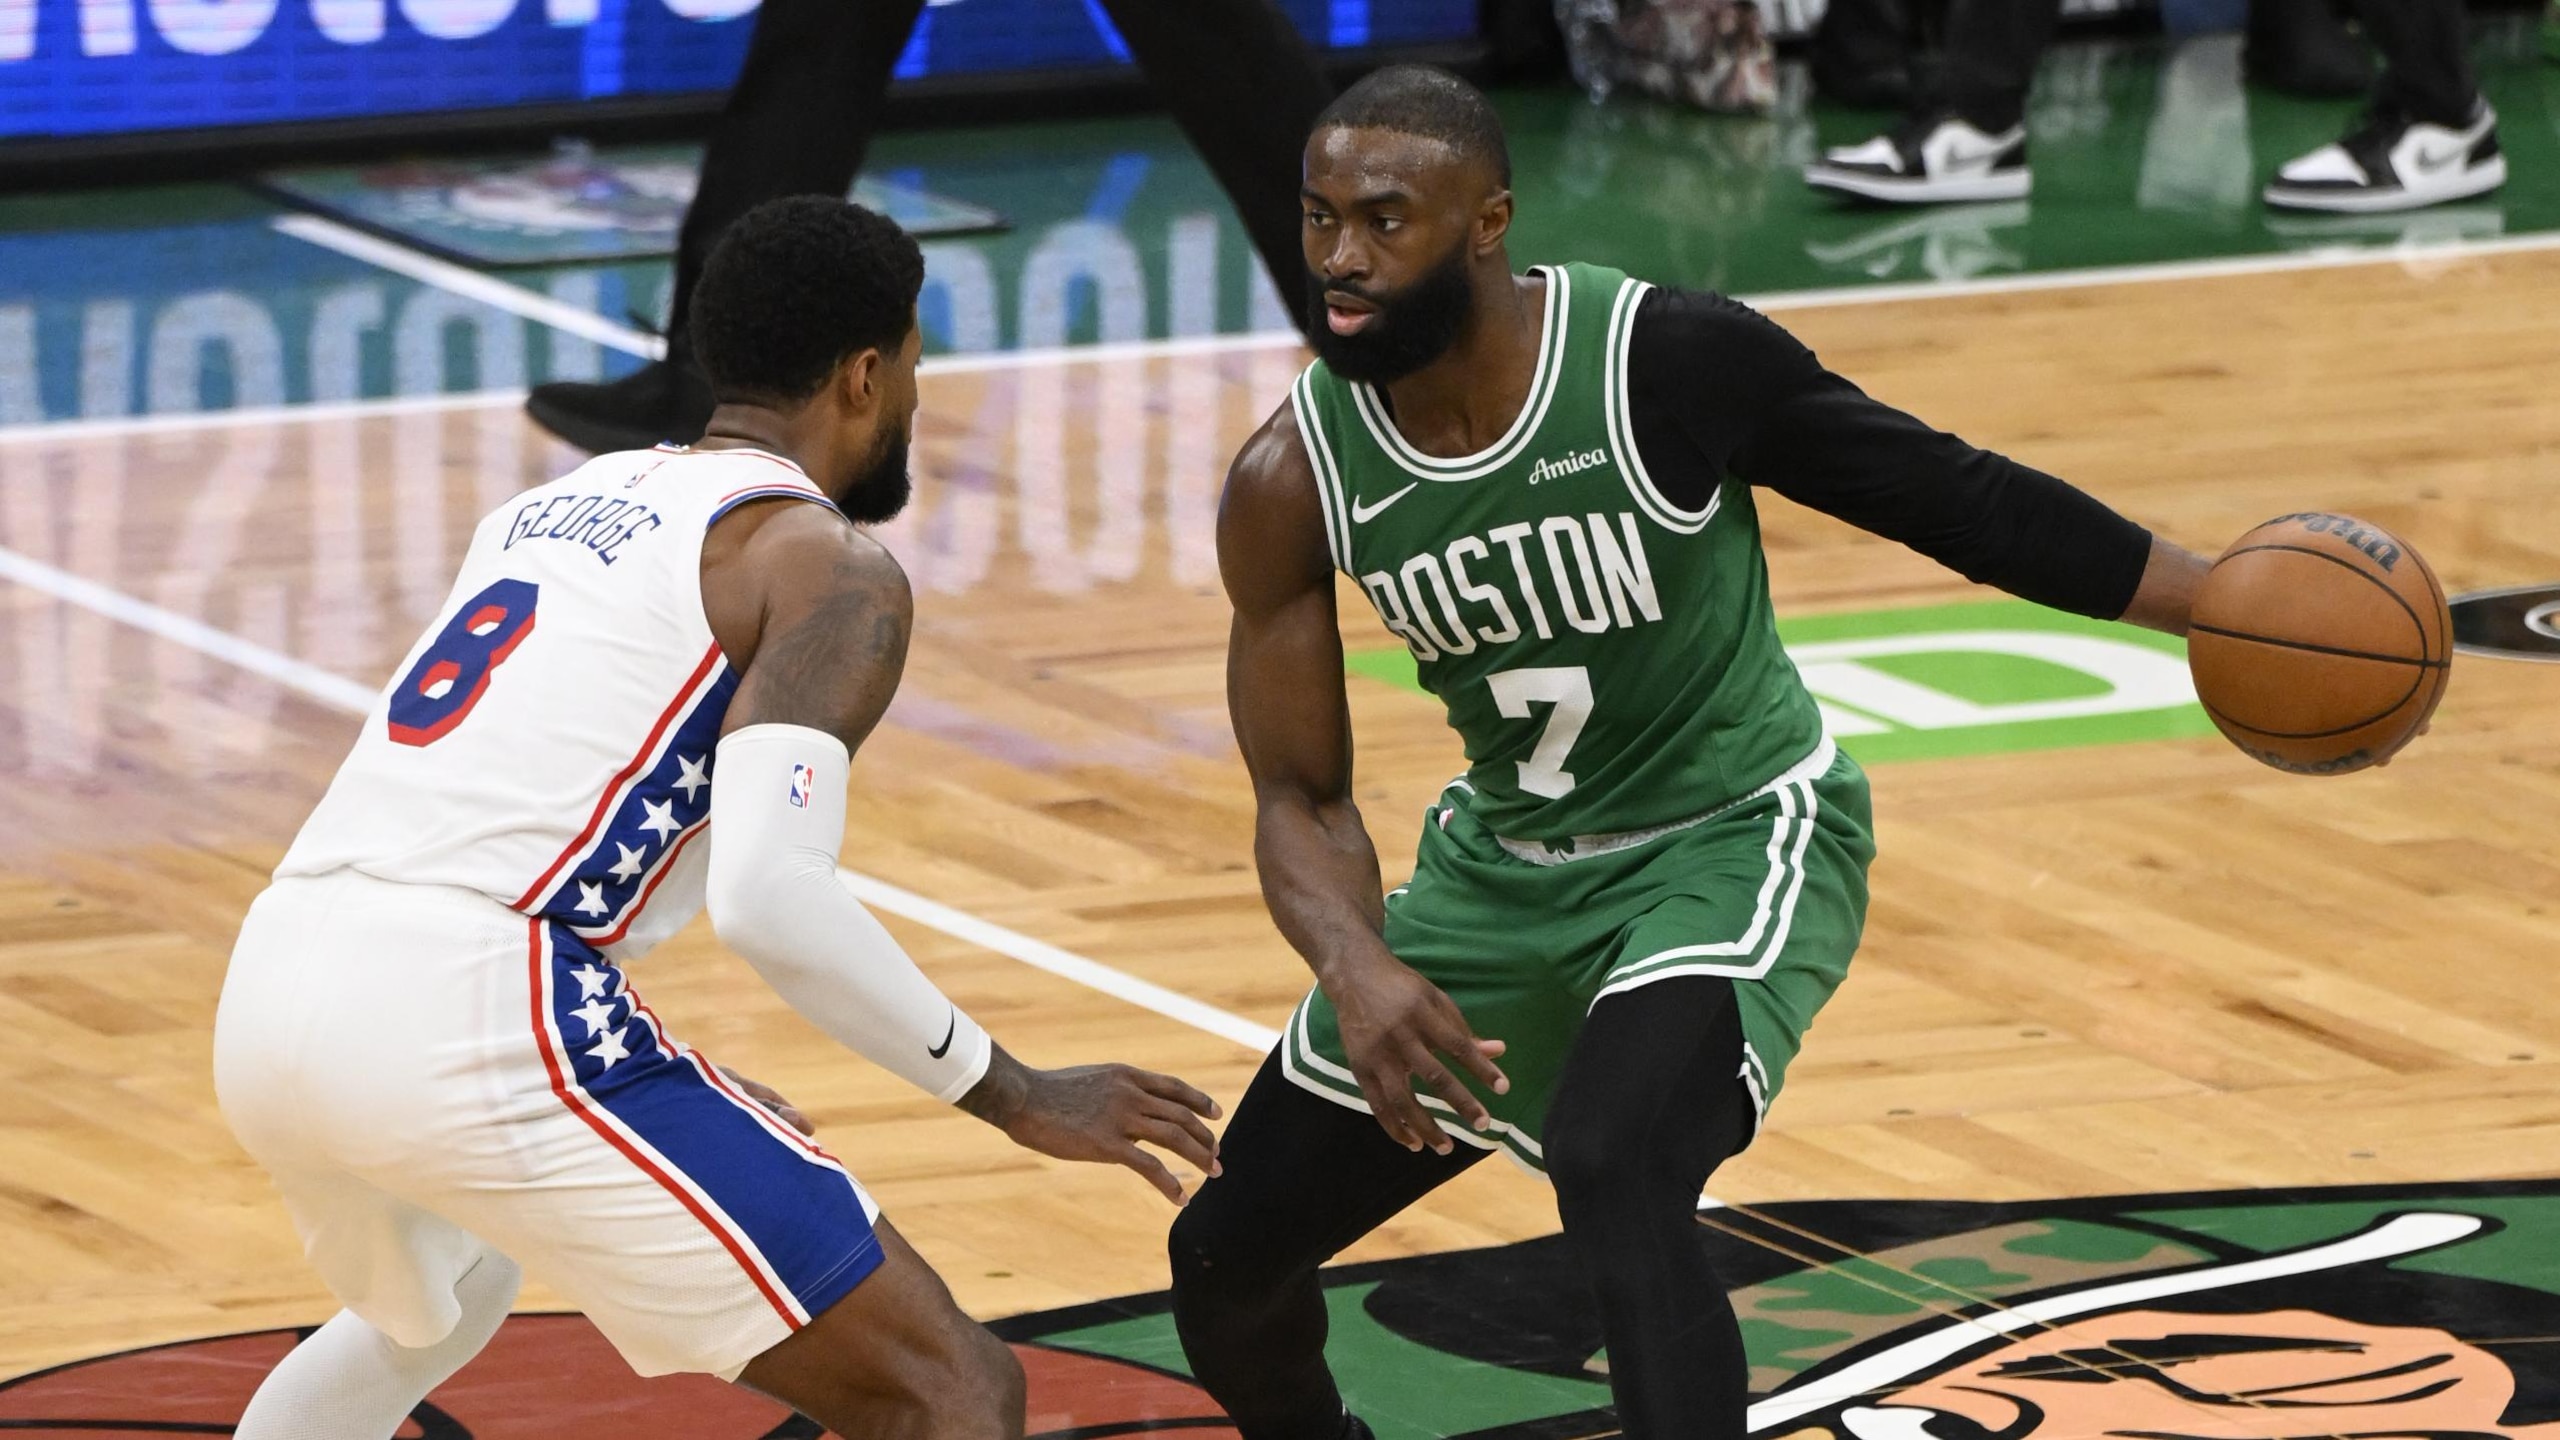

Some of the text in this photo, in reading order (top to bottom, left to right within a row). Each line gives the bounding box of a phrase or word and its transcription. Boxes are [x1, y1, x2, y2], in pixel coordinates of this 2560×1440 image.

[503, 495, 662, 566] GEORGE
[1529, 448, 1608, 485] Amica
[1360, 512, 1663, 662] BOSTON
[388, 578, 539, 748] 8
[1485, 666, 1595, 800] 7
